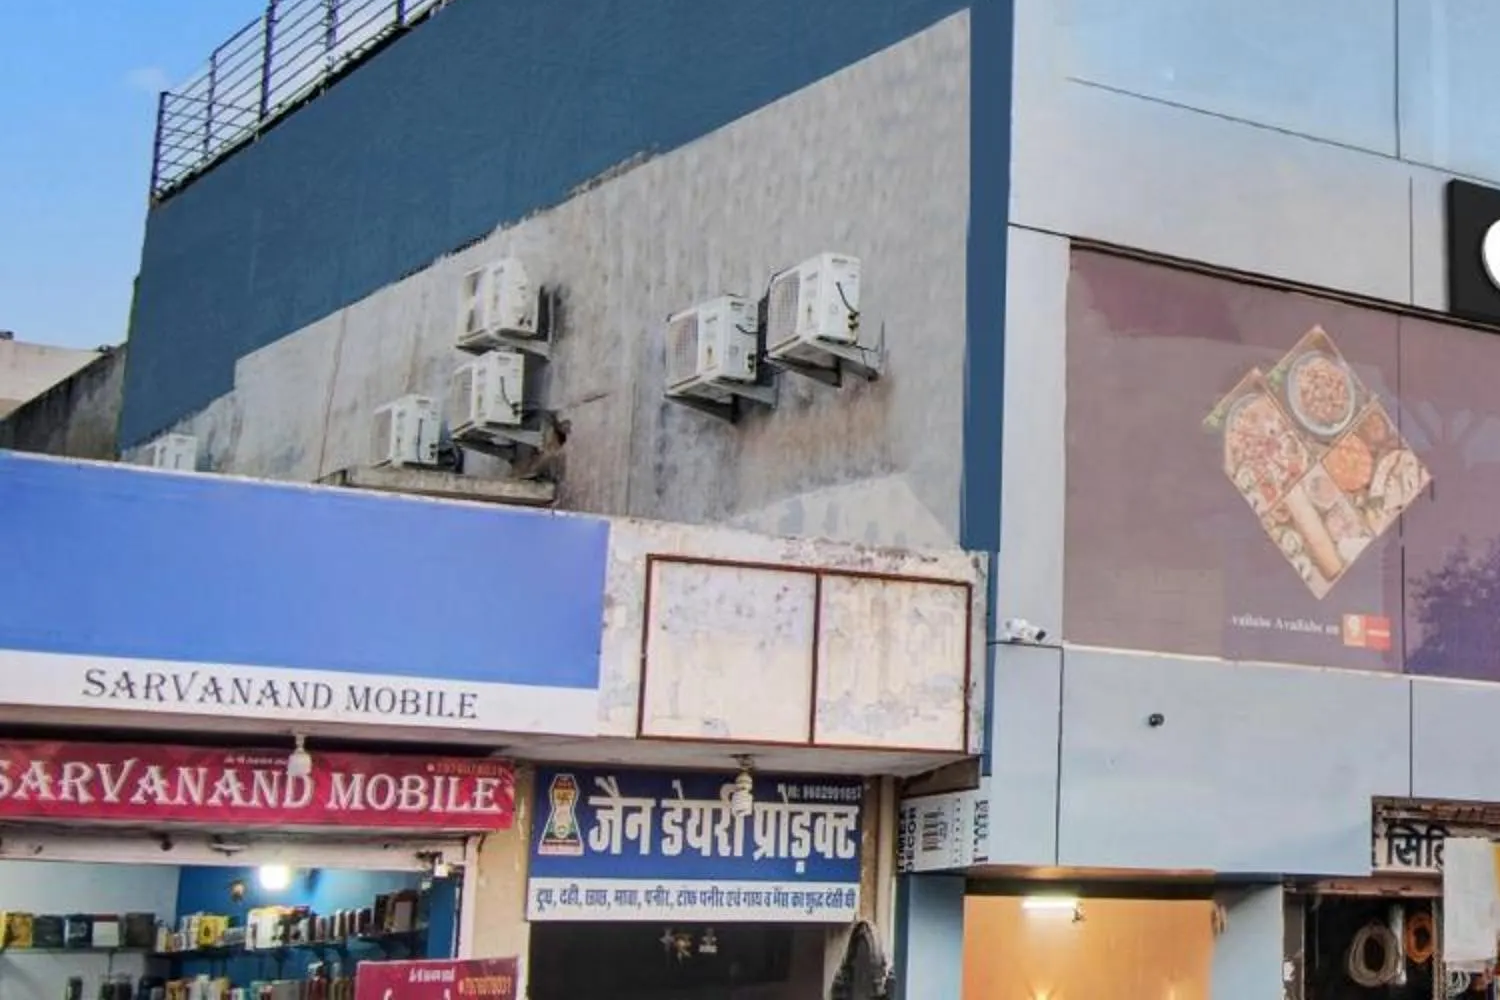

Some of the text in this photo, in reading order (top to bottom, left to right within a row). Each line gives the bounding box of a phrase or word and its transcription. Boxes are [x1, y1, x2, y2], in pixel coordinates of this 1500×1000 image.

[81, 668, 480, 719] SARVANAND MOBILE
[326, 772, 502, 813] MOBILE
[588, 775, 656, 855] जैन
